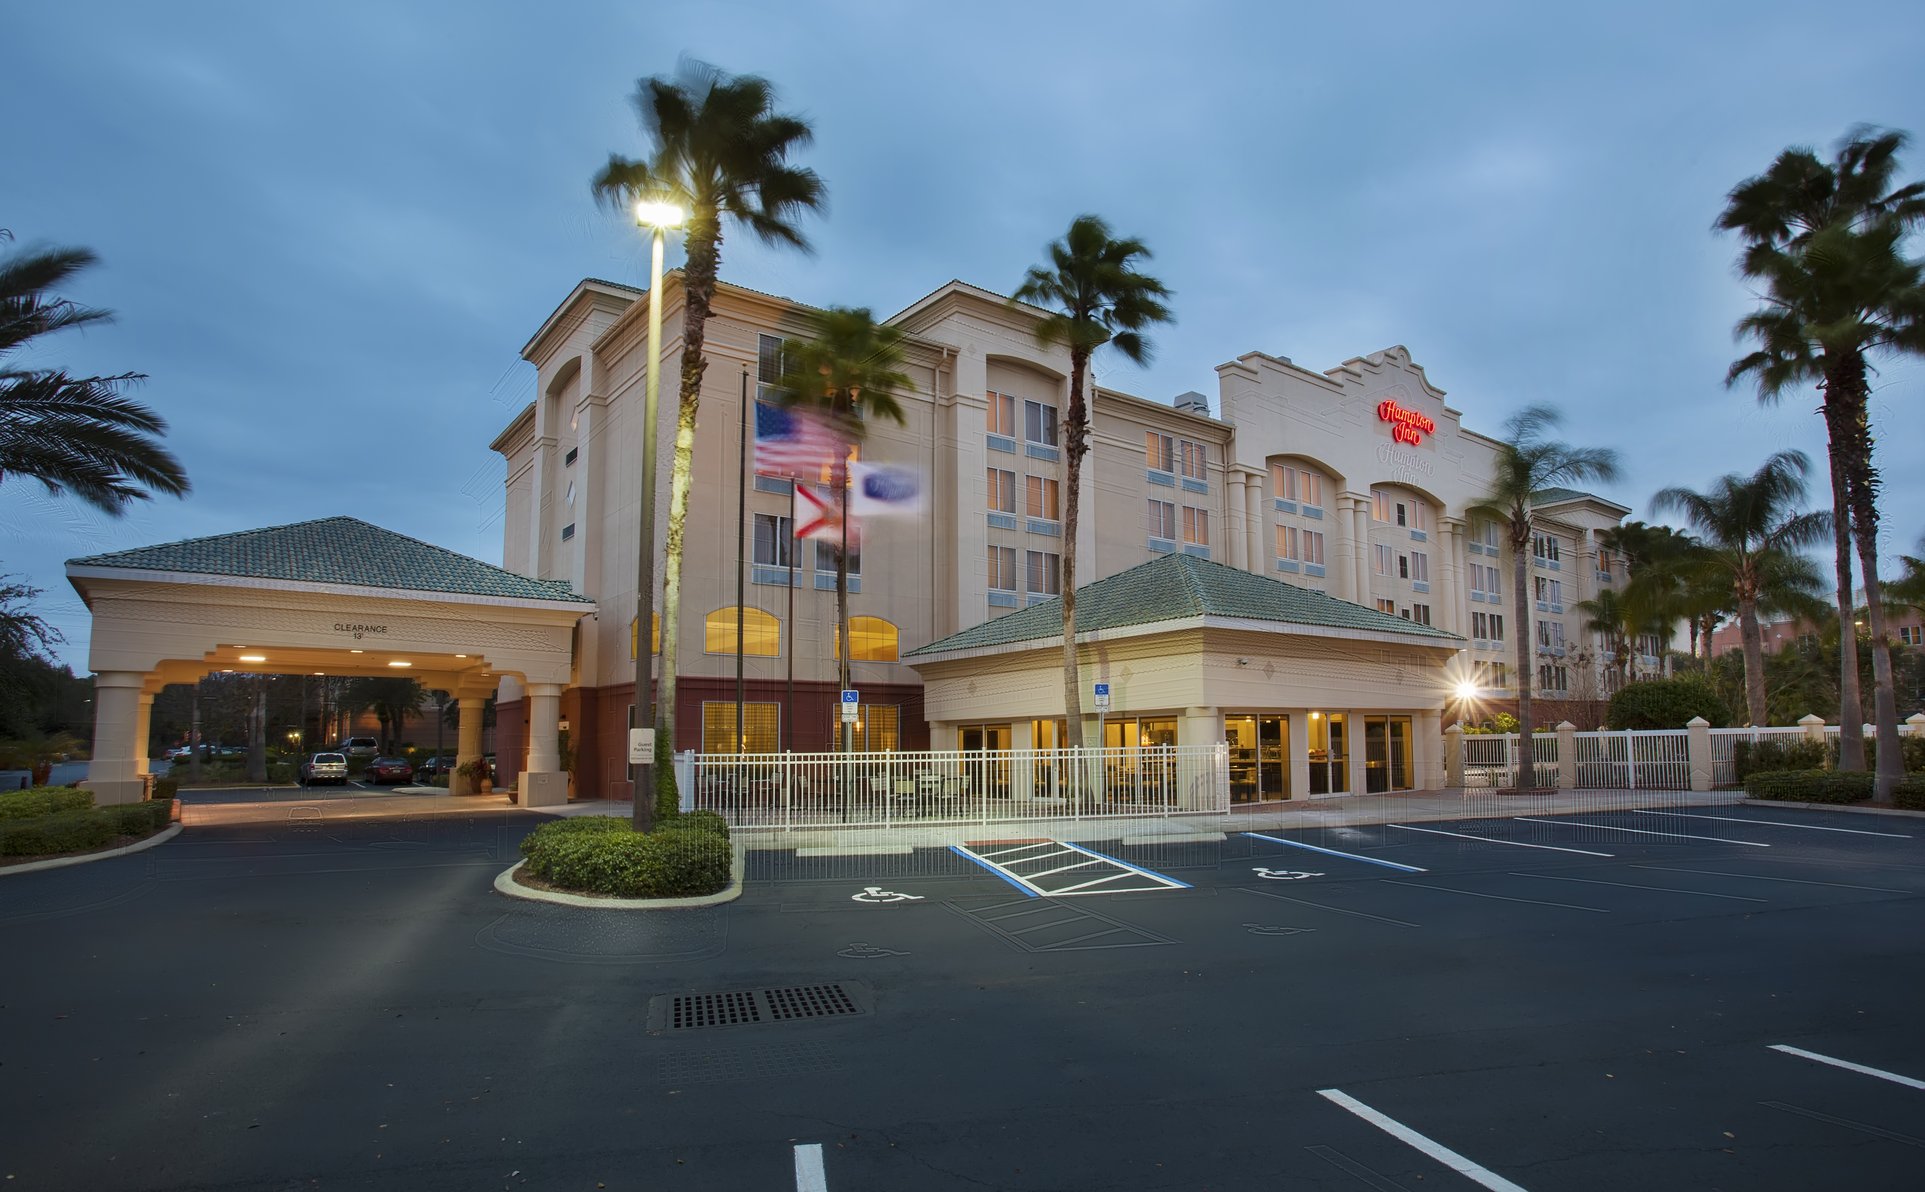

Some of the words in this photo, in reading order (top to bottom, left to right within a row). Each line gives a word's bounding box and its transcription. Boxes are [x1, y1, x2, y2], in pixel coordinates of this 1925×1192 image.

[1377, 399, 1435, 434] Hampton
[1392, 421, 1421, 446] Inn
[334, 623, 387, 633] CLEARANCE
[353, 632, 364, 640] 13'
